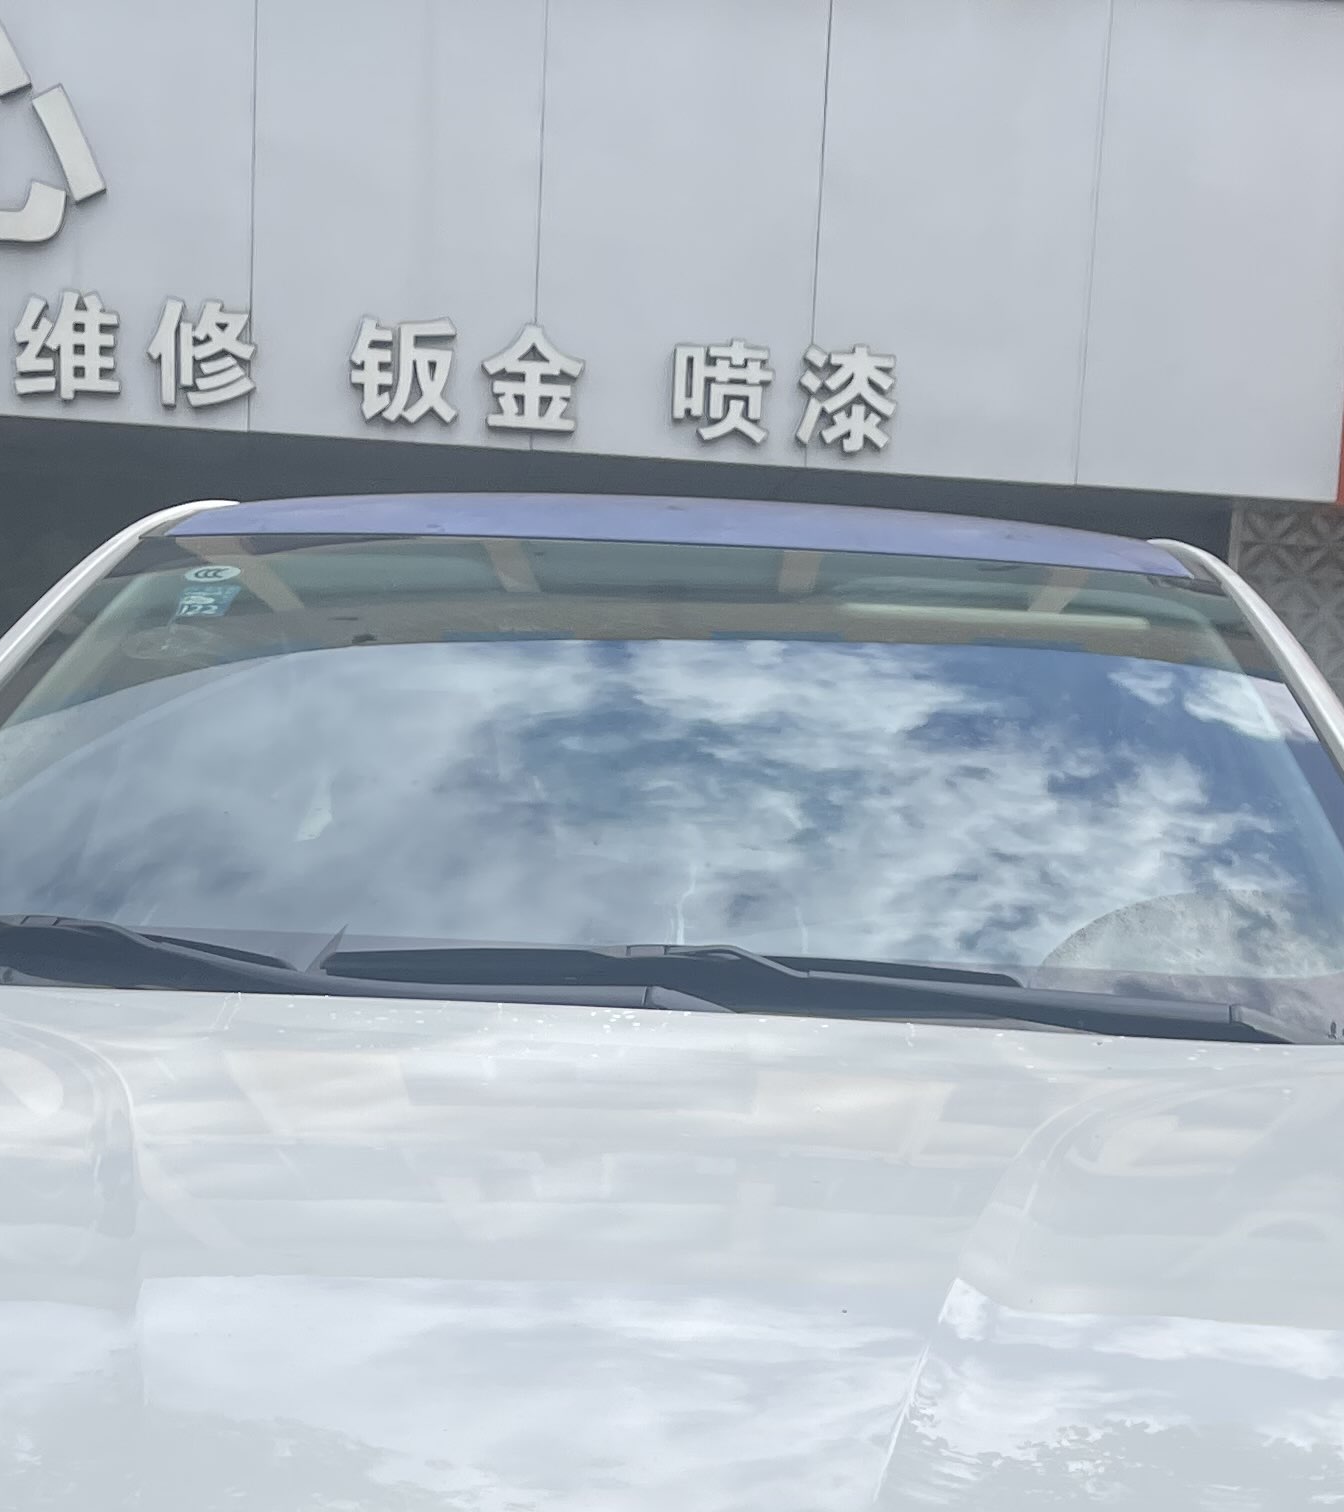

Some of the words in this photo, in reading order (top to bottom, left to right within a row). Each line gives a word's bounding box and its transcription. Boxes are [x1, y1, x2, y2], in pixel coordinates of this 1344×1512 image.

[13, 290, 256, 408] 维修
[350, 316, 585, 433] 钣金
[671, 338, 898, 453] 喷漆
